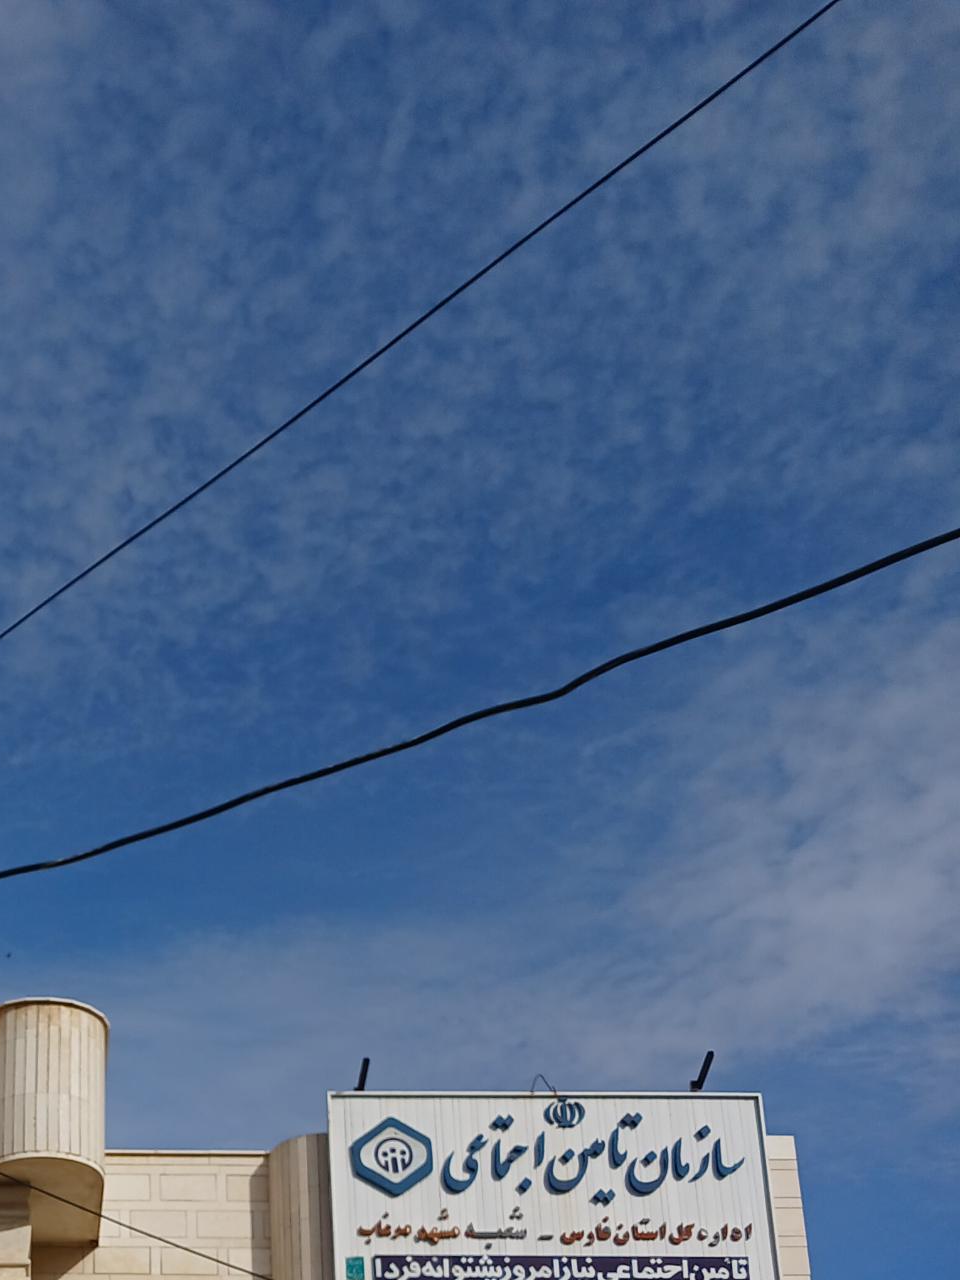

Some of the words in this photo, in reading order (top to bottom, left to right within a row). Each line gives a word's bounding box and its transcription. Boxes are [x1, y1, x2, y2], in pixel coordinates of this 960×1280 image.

[440, 1115, 544, 1195] اجتماعی
[625, 1125, 745, 1196] سازمان
[357, 1212, 412, 1245] مرغاب
[464, 1206, 527, 1250] شعبه
[560, 1216, 611, 1247] فارس
[613, 1218, 667, 1246] استان
[668, 1222, 695, 1246] کل
[696, 1223, 752, 1247] اداره
